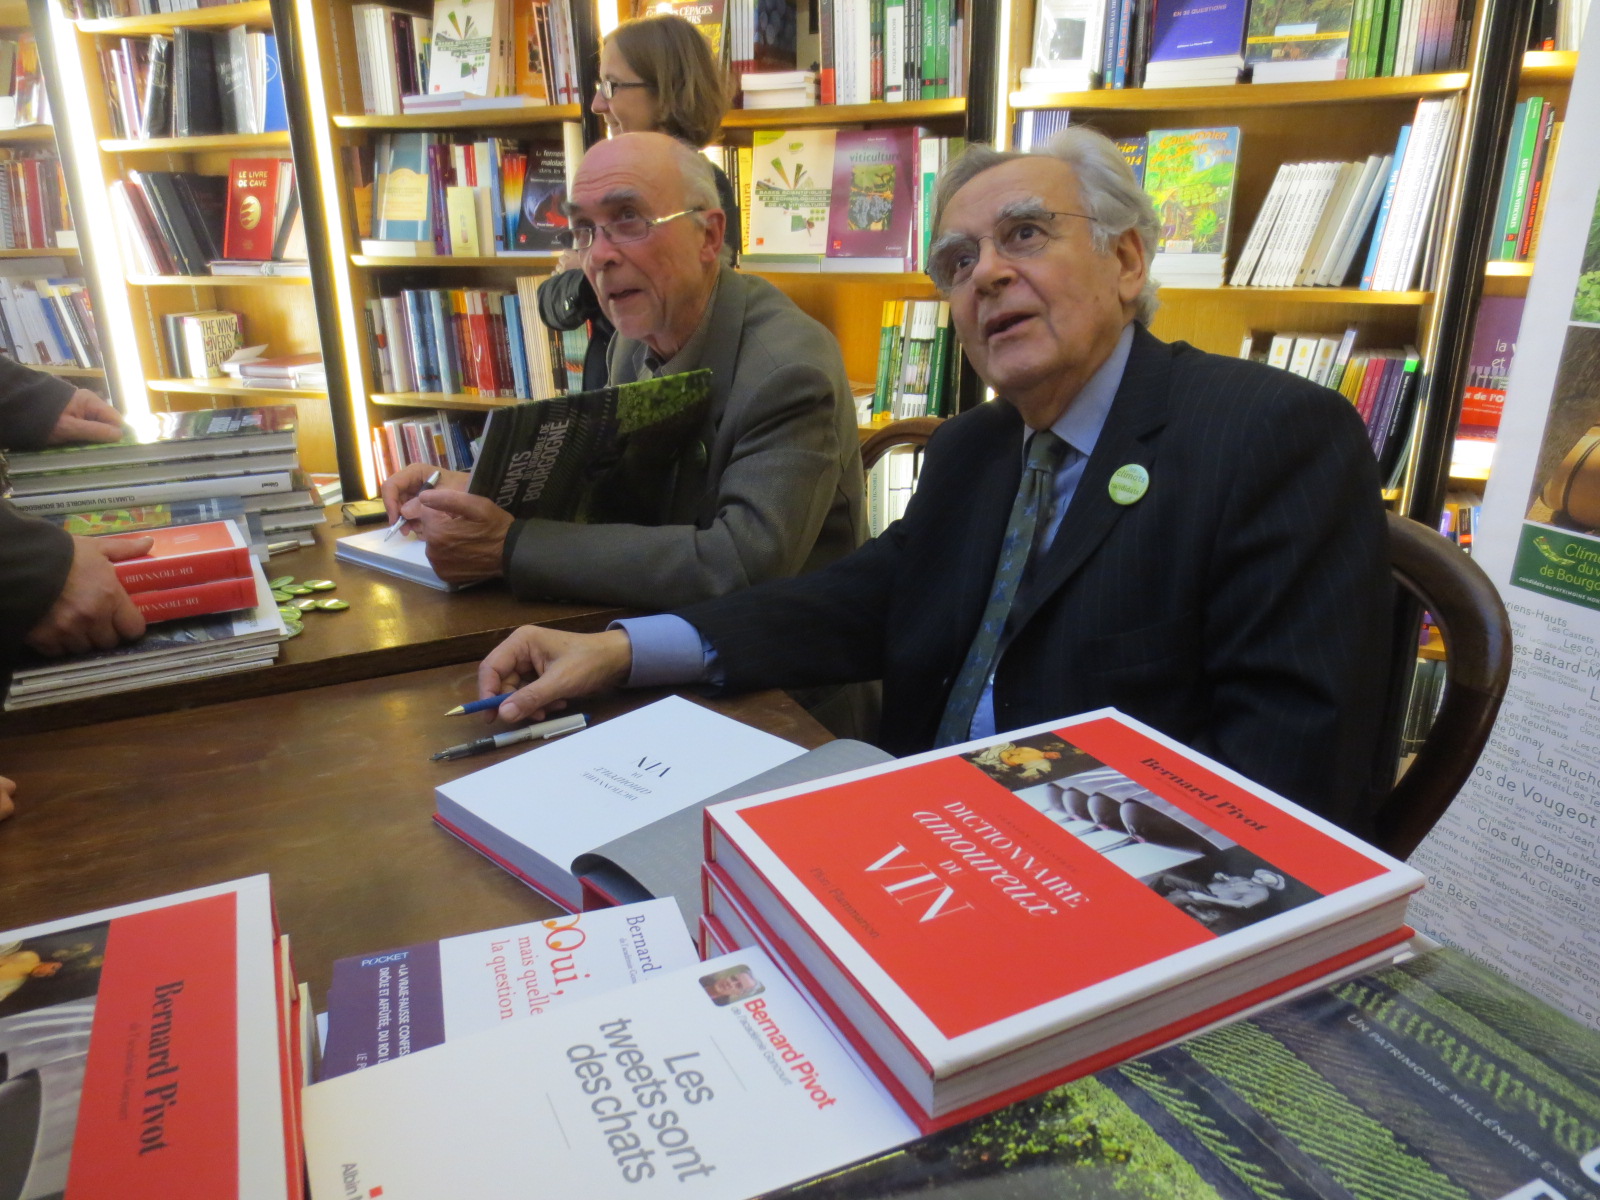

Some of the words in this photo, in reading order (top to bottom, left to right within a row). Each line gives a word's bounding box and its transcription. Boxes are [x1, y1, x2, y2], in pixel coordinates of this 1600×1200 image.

[1191, 4, 1227, 14] QUESTIONS
[850, 152, 902, 162] viticulture
[1516, 169, 1527, 197] TERROIRS
[1510, 198, 1520, 228] VITICOLES
[201, 320, 216, 336] THE
[216, 317, 236, 334] WINE
[1496, 339, 1506, 352] la
[1492, 358, 1505, 368] et
[1474, 392, 1487, 400] de
[522, 418, 570, 503] BOURGOGNE
[528, 436, 546, 469] VIGNOBLE
[540, 423, 551, 434] DE
[496, 450, 532, 507] CLIMATS
[66, 499, 96, 507] VIGNOBLE
[1540, 564, 1554, 578] de
[1578, 562, 1593, 575] du
[1518, 577, 1545, 588] candidats
[1552, 586, 1586, 600] PATRIMOINE
[1547, 624, 1561, 634] Les
[1563, 639, 1582, 653] Les
[1508, 690, 1524, 701] Clos
[1525, 696, 1571, 719] Saint-Denis
[1563, 702, 1576, 714] Les
[1504, 708, 1519, 721] Les
[1522, 716, 1569, 740] Reuchaux
[1508, 727, 1545, 751] Dumay
[1576, 739, 1590, 751] Les
[630, 756, 672, 778] VIN
[1482, 754, 1509, 772] Forêts
[1537, 750, 1554, 768] La
[580, 771, 638, 801] DICTIONNAIRE
[1510, 763, 1524, 774] Sur
[1526, 769, 1538, 780] les
[1540, 775, 1565, 792] Forêts
[1521, 759, 1561, 779] Ruchottes
[1574, 781, 1589, 792] Bas
[1140, 758, 1219, 802] Bernard
[1216, 801, 1268, 831] Pivot
[1484, 785, 1514, 806] Girard
[1496, 774, 1516, 792] de
[1522, 782, 1597, 829] Vougeot
[1566, 785, 1585, 802] Les
[1427, 832, 1459, 855] Manche
[1535, 814, 1595, 849] Saint-Jean
[912, 810, 1058, 917] amoureux
[944, 801, 1090, 909] DICTIONNAIRE
[1414, 847, 1462, 877] Saint-Jean
[1460, 835, 1470, 845] de
[1471, 841, 1522, 871] Nampoillon
[1478, 817, 1507, 842] Clos
[1511, 835, 1530, 852] du
[1534, 844, 1600, 887] Chapitre
[1567, 847, 1578, 859] Le
[864, 842, 975, 923] VIN
[938, 860, 968, 877] DU
[1520, 850, 1587, 892] Richebourgs
[1428, 874, 1444, 890] de
[1447, 883, 1478, 910] Bèze
[1473, 865, 1488, 880] Les
[1490, 876, 1535, 904] Rebichets
[1520, 872, 1536, 886] Au
[1539, 881, 1586, 912] Closeau
[1419, 890, 1450, 913] Pruliers
[1478, 909, 1492, 921] Les
[490, 939, 511, 954] la
[518, 936, 536, 967] mais
[626, 914, 662, 973] Bernard
[1424, 923, 1436, 936] La
[1439, 932, 1466, 953] Croix
[1468, 948, 1510, 978] Violette
[1559, 942, 1577, 958] Aux
[362, 952, 409, 967] POCKET
[1506, 944, 1522, 959] Les
[1524, 954, 1570, 987] Fleurières
[1553, 954, 1573, 972] Les
[379, 967, 392, 988] DRÔLE
[486, 956, 514, 1020] question
[399, 976, 409, 1025] VRAIE-FAUSSE
[516, 969, 551, 1016] quelle
[1577, 1004, 1593, 1020] Le
[146, 980, 184, 1080] Bernard
[378, 1030, 390, 1042] DU
[356, 1053, 368, 1062] LE
[378, 1042, 390, 1058] ROI
[731, 1006, 742, 1018] de
[763, 1050, 793, 1087] Goncourt
[744, 998, 804, 1063] Bernard
[790, 1060, 837, 1110] Pivot
[663, 1052, 714, 1105] Les
[1347, 1013, 1370, 1033] UN
[1369, 1031, 1450, 1094] PATRIMOINE
[1450, 1093, 1541, 1162] MILLÉNAIRE
[566, 1044, 612, 1095] des
[591, 1095, 656, 1184] chats
[599, 1018, 667, 1109] tweets
[647, 1109, 716, 1183] sont
[138, 1081, 178, 1157] Pivot
[341, 1162, 358, 1195] Albin
